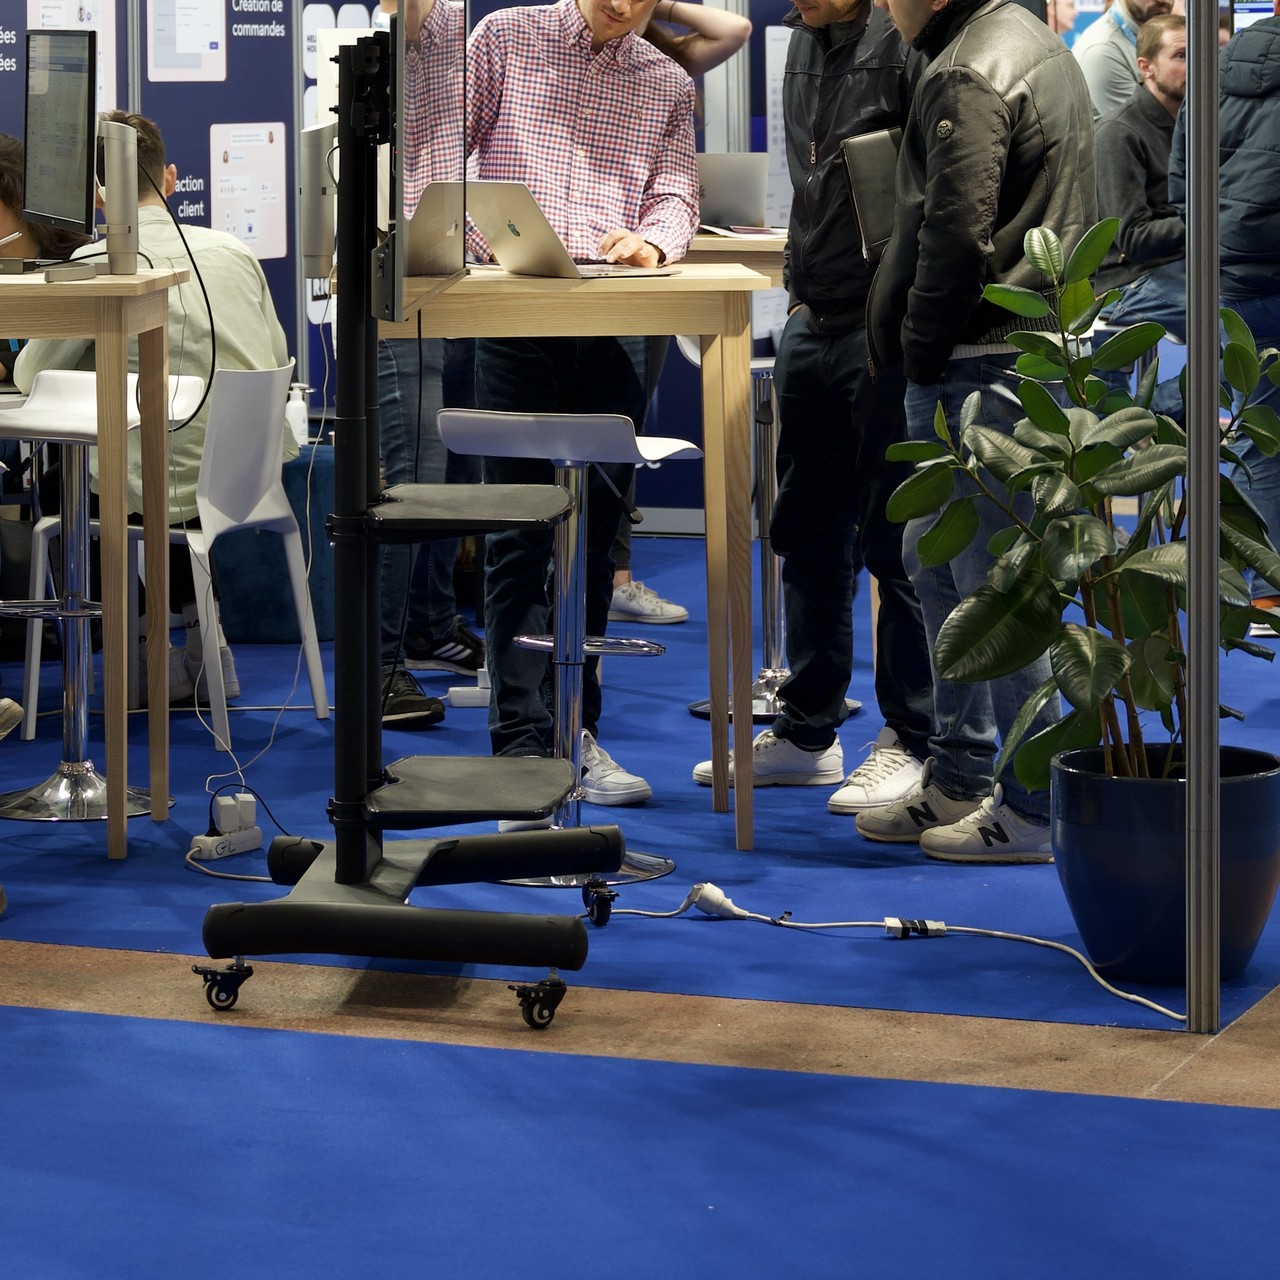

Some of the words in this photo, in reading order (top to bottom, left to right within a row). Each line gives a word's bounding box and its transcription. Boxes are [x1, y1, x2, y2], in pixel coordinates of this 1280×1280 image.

[232, 21, 285, 37] commandes
[175, 176, 203, 192] action
[178, 201, 204, 217] client
